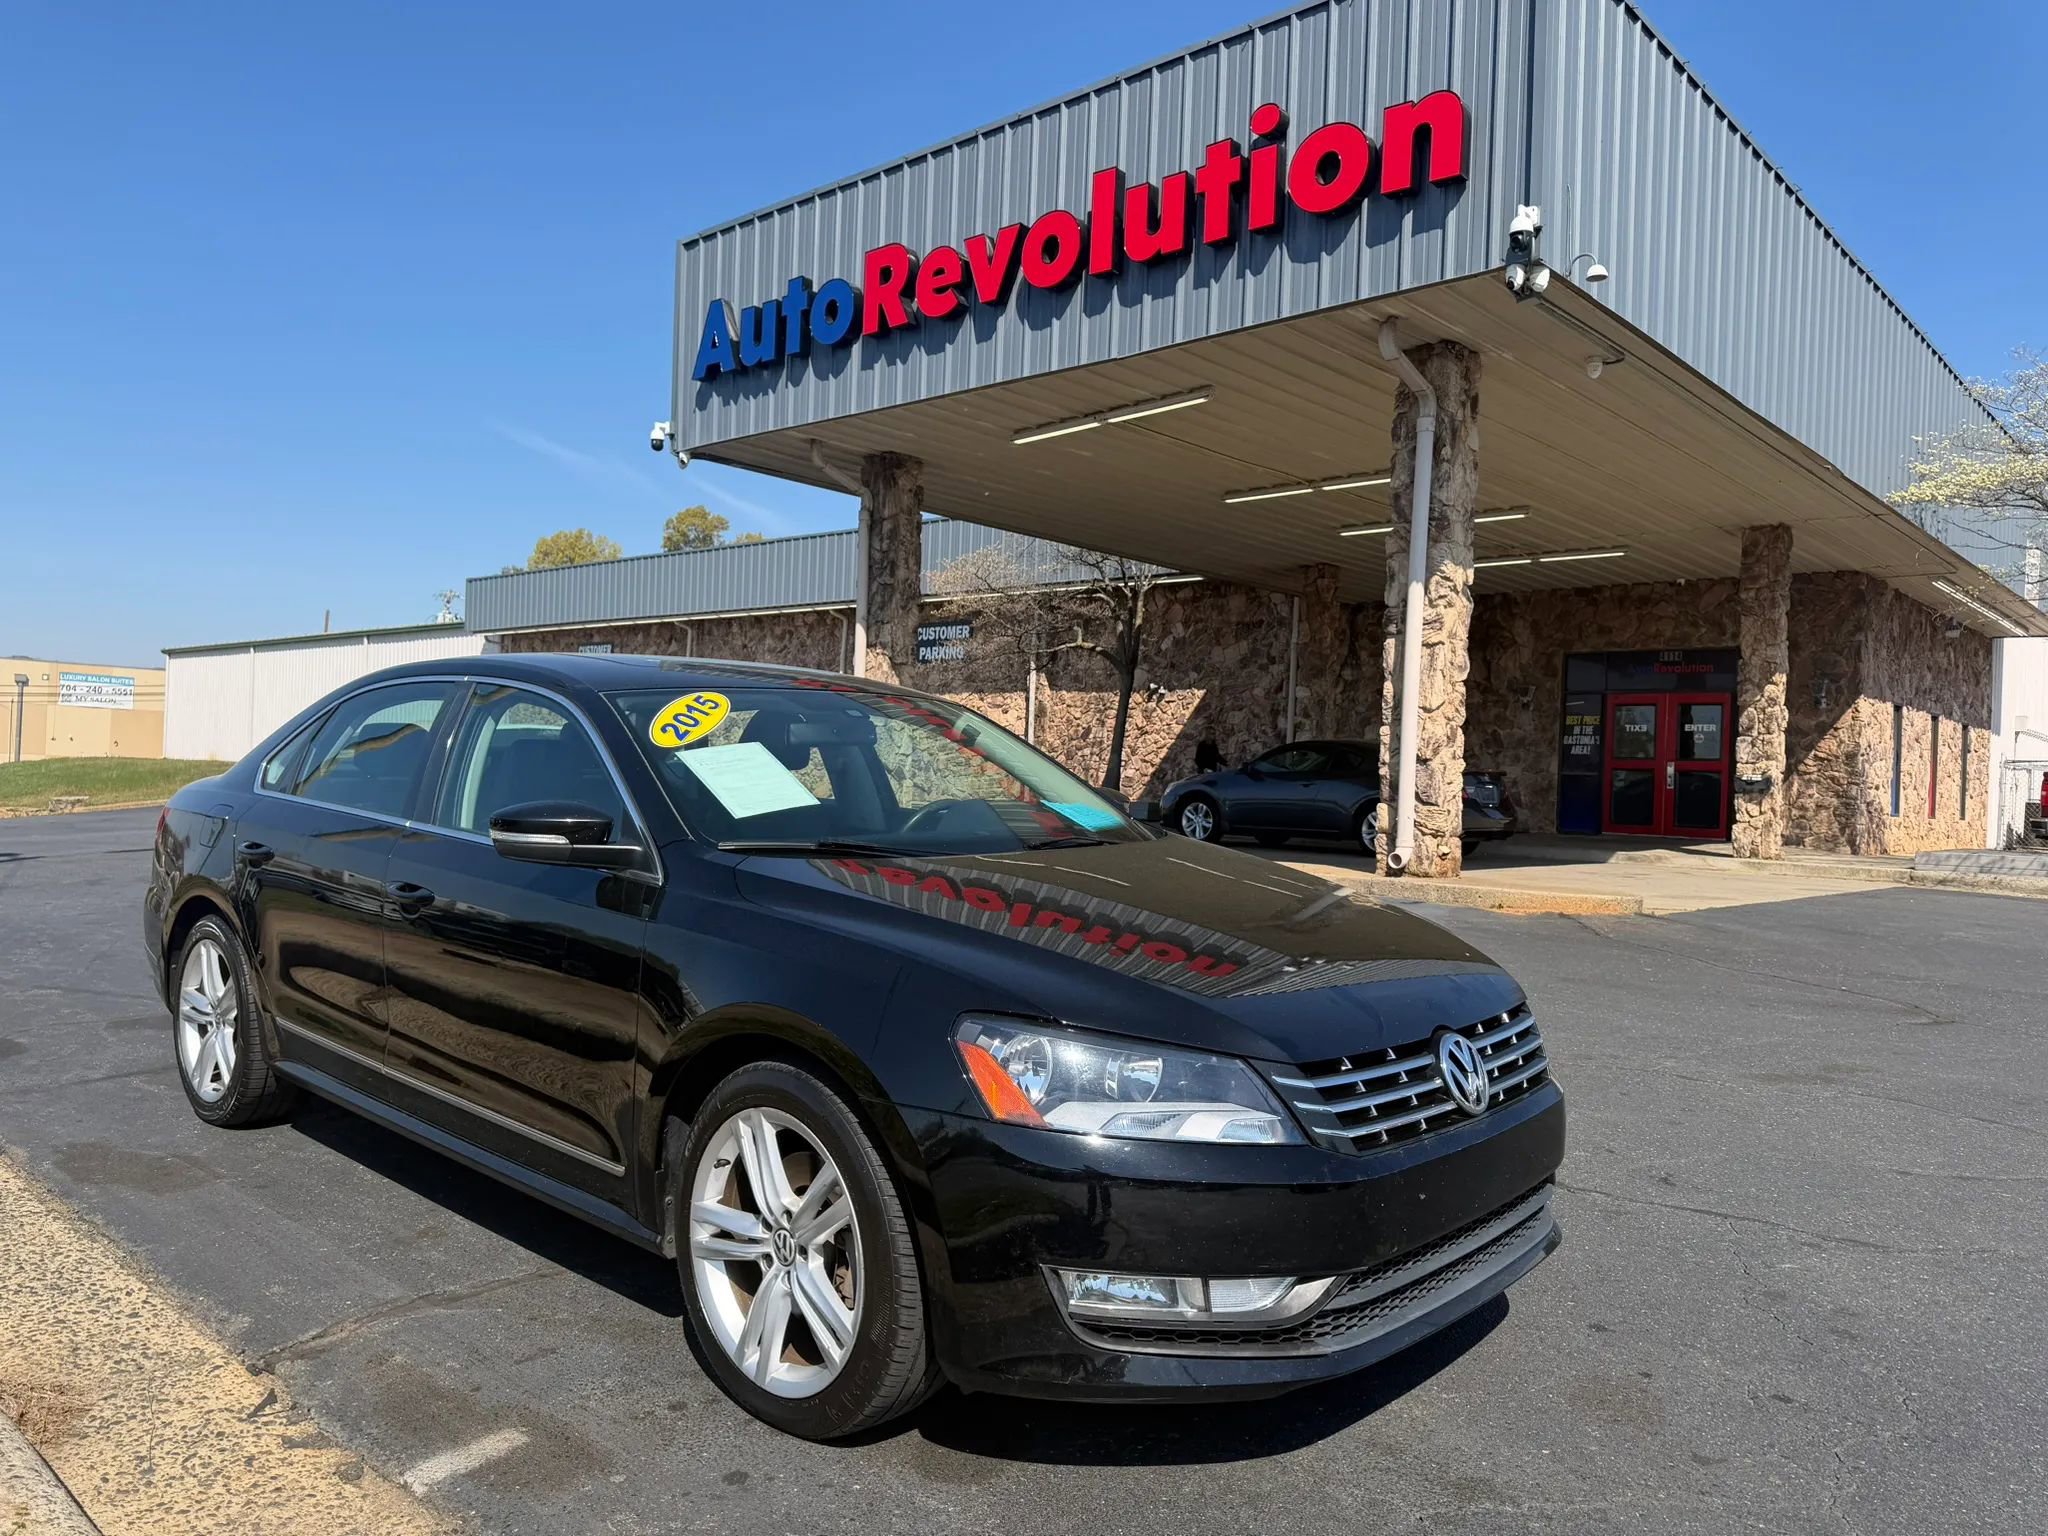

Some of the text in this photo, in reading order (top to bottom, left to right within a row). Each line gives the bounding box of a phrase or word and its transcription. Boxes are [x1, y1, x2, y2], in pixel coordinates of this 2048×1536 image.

[692, 89, 1468, 381] AutoRevolution
[917, 624, 970, 640] CUSTOMER
[919, 645, 964, 660] PARKING
[87, 675, 111, 684] SALON
[660, 694, 722, 742] 2015
[1684, 723, 1717, 732] ENTER
